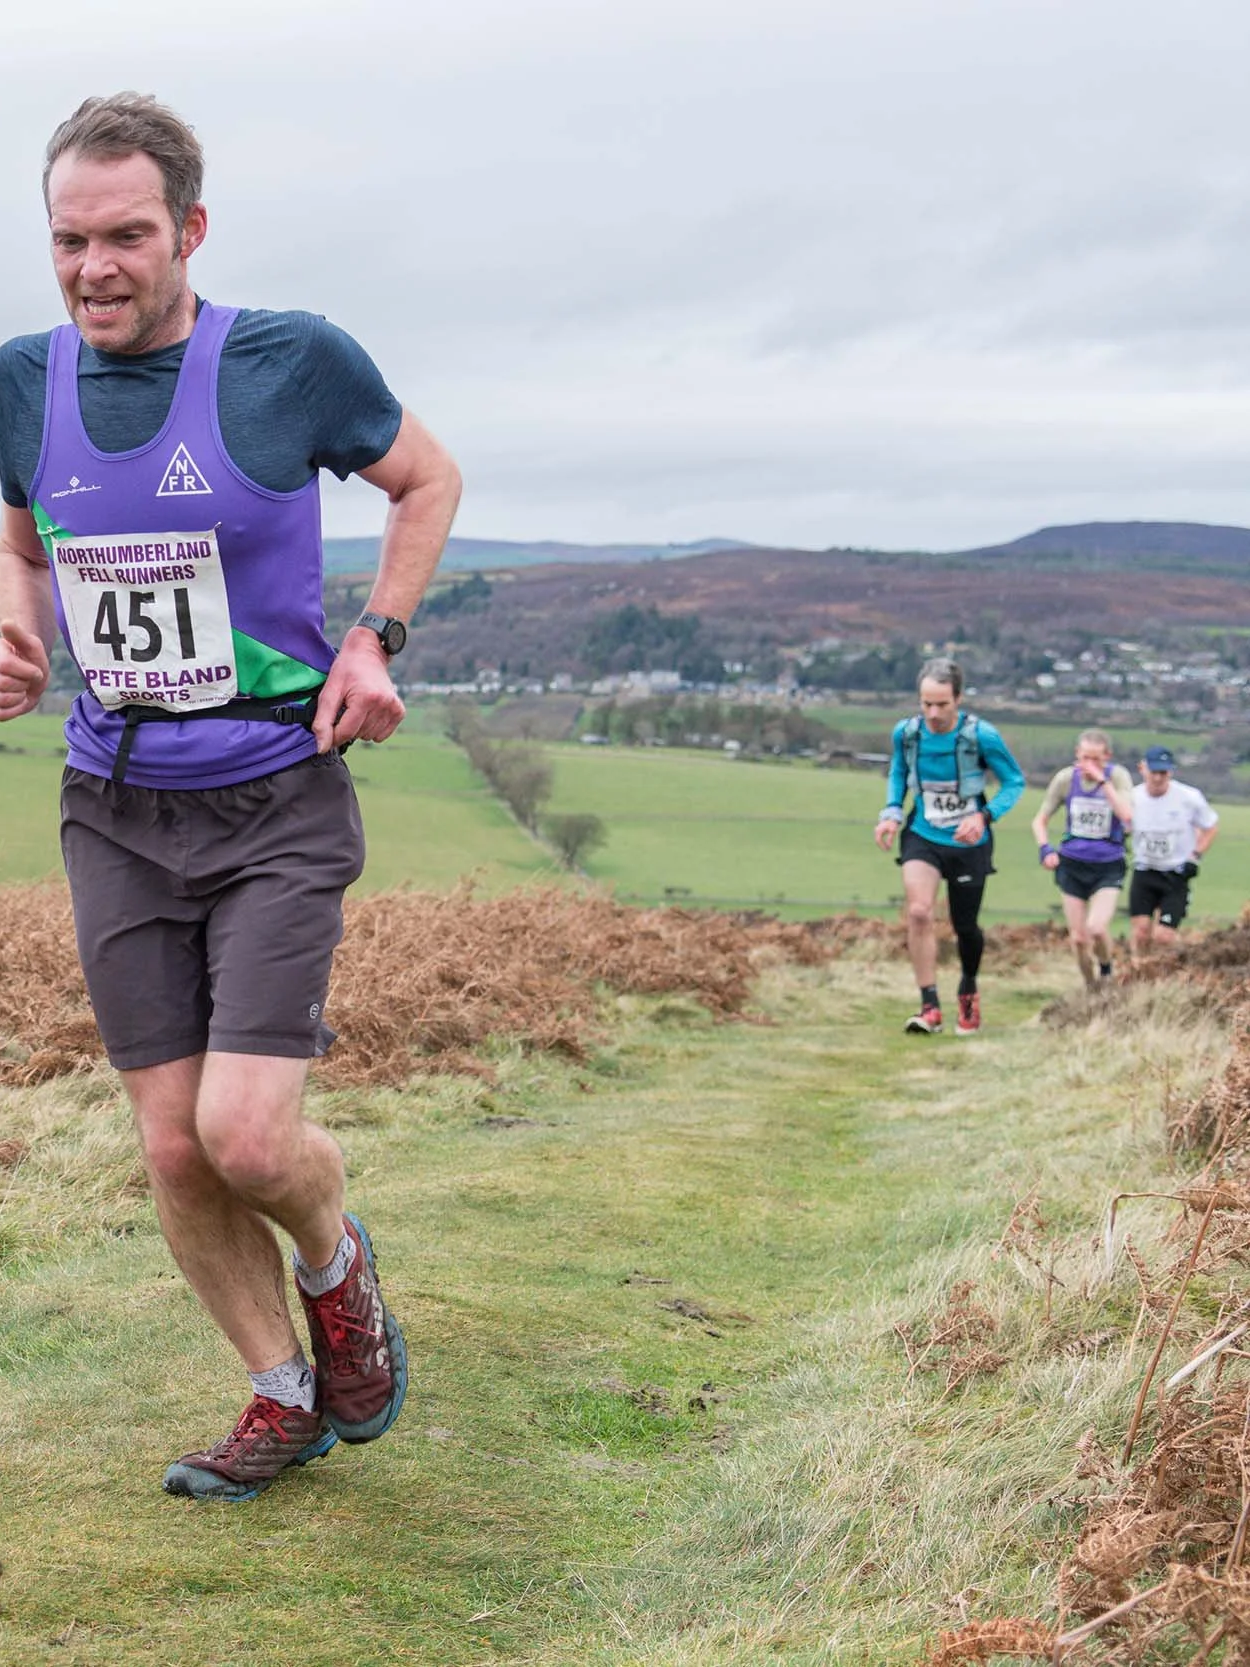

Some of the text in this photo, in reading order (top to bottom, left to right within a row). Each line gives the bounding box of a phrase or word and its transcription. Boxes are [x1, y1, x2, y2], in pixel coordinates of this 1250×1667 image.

[176, 459, 188, 475] N
[57, 541, 212, 565] NORTHUMBERLAND
[78, 564, 196, 584] FELL RUNNERS
[93, 587, 197, 662] 451
[85, 665, 232, 688] PETE BLAND
[119, 689, 191, 703] SPORTS
